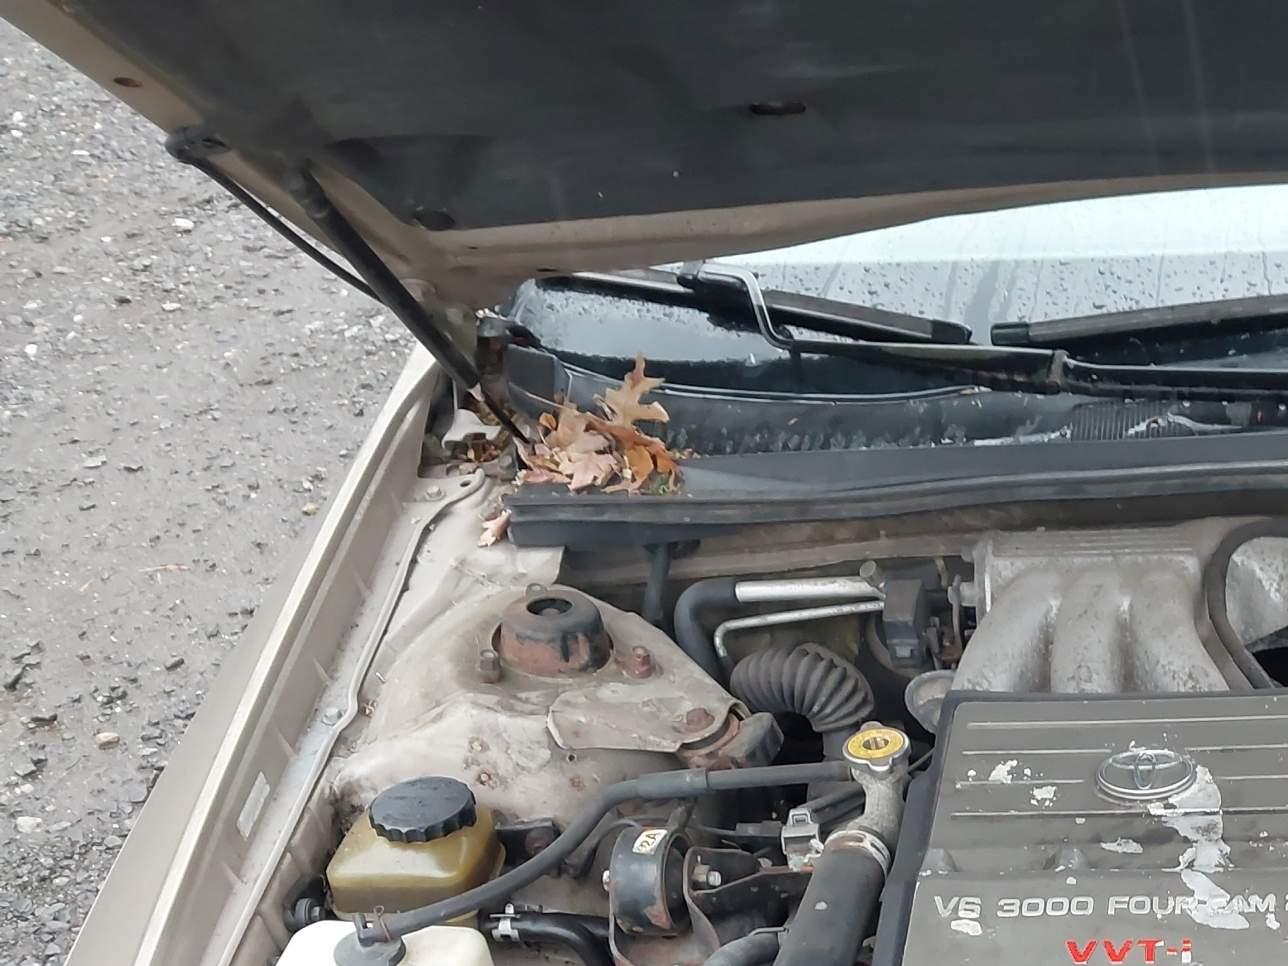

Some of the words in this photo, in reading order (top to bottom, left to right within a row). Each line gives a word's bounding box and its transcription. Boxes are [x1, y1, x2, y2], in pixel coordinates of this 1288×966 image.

[933, 895, 982, 918] V6
[997, 895, 1095, 918] 3000
[1066, 939, 1194, 965] VVT-i
